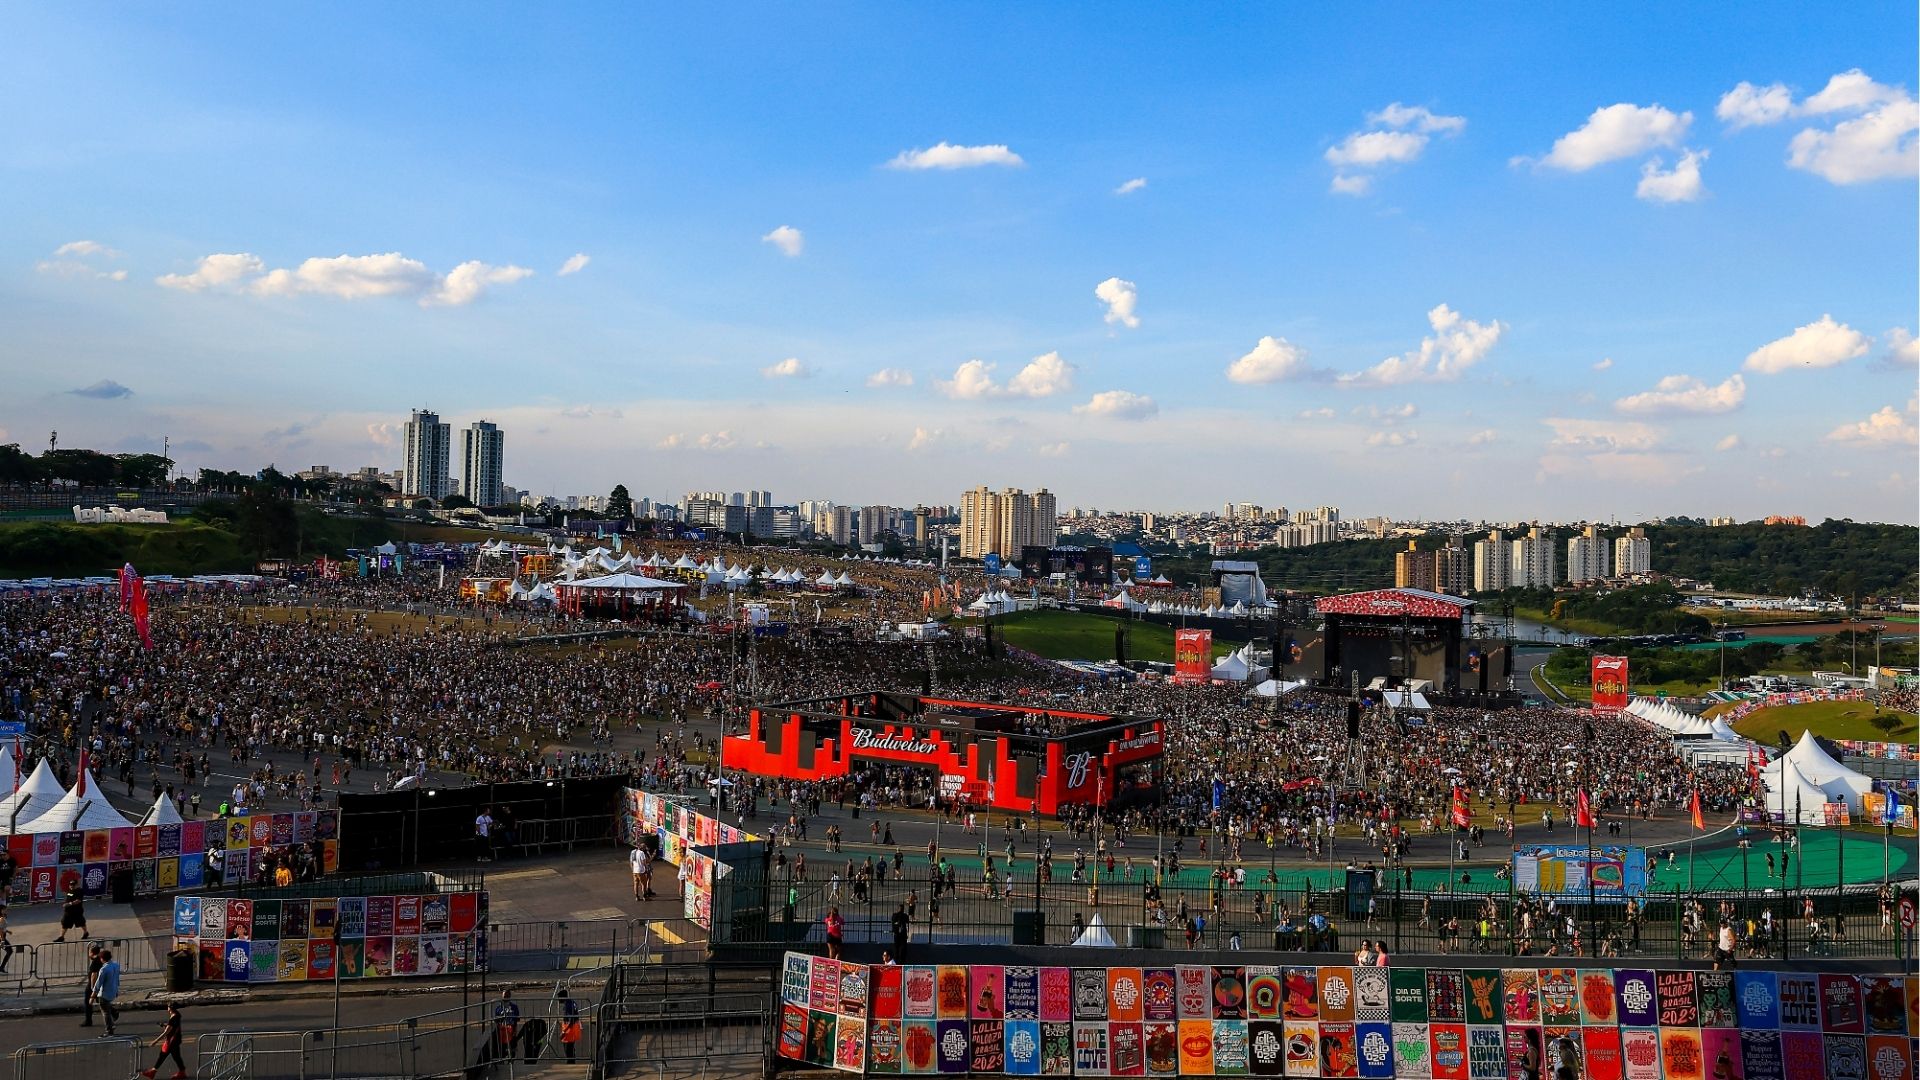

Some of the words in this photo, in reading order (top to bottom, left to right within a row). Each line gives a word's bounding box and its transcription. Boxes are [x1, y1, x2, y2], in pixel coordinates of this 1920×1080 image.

[850, 728, 936, 754] Budweiser
[944, 782, 962, 791] NOSSO
[945, 774, 966, 783] MUNDO
[788, 956, 809, 972] REUSE
[785, 970, 810, 986] REDUZA
[1658, 972, 1693, 986] LOLLA
[1699, 973, 1732, 981] ALIENS
[784, 985, 809, 1004] RECICLE
[1658, 983, 1693, 998] PALOOZA
[1780, 980, 1817, 1003] LOVE
[1395, 995, 1423, 1003] SORTE
[1662, 997, 1692, 1008] BRASIL
[1660, 1007, 1696, 1025] 2023
[1781, 1002, 1818, 1025] LOVE
[972, 1021, 1003, 1034] LOLLA
[1045, 1029, 1069, 1037] EXIST
[972, 1031, 1001, 1045] PALOOZA
[1077, 1028, 1106, 1049] LOVE
[1472, 1030, 1501, 1046] REUSE
[975, 1044, 1000, 1056] BRASIL
[1470, 1046, 1505, 1062] REDUZA
[972, 1053, 1004, 1071] 2023
[1077, 1049, 1107, 1069] LOVE
[1470, 1061, 1508, 1078] RECICLE
